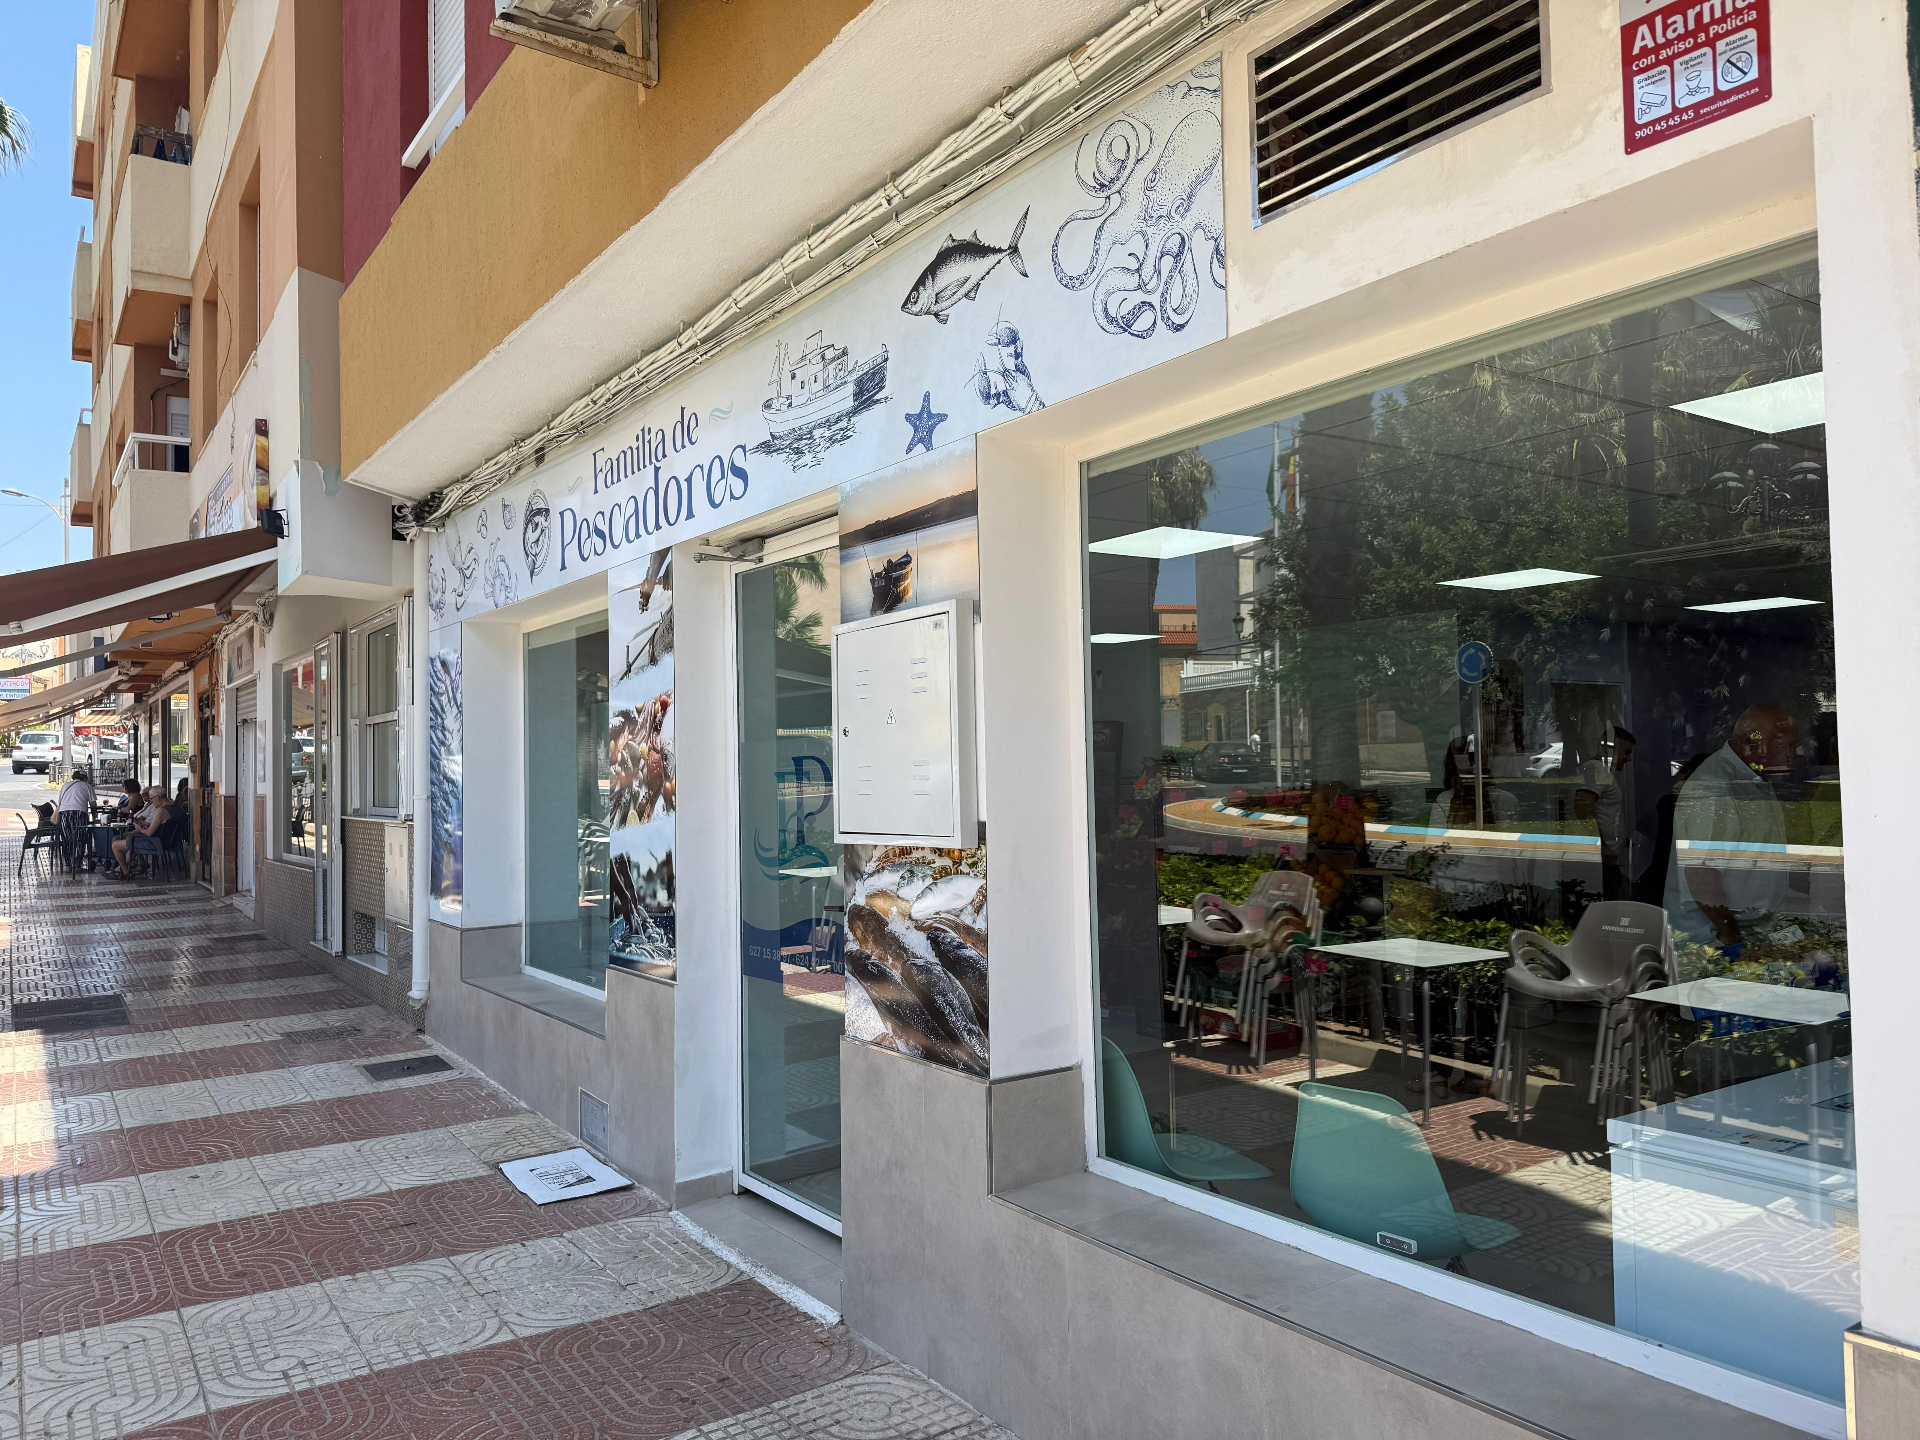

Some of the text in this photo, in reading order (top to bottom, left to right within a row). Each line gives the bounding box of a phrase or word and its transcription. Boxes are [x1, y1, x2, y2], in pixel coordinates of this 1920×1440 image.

[1632, 9, 1757, 71] con aviso a Policía
[1724, 33, 1748, 48] Alarma
[1679, 51, 1707, 67] Vigilante
[1637, 68, 1667, 85] Grabación
[1699, 86, 1760, 115] securitasdirect.es
[1634, 125, 1654, 140] 900
[1655, 121, 1667, 132] 45
[1668, 115, 1680, 126] 45
[1681, 109, 1695, 121] 45
[592, 405, 699, 496] Familia de
[558, 443, 750, 572] Pescadores
[749, 945, 761, 957] 627
[762, 948, 771, 959] 15
[772, 950, 780, 961] 38
[795, 954, 809, 966] 624
